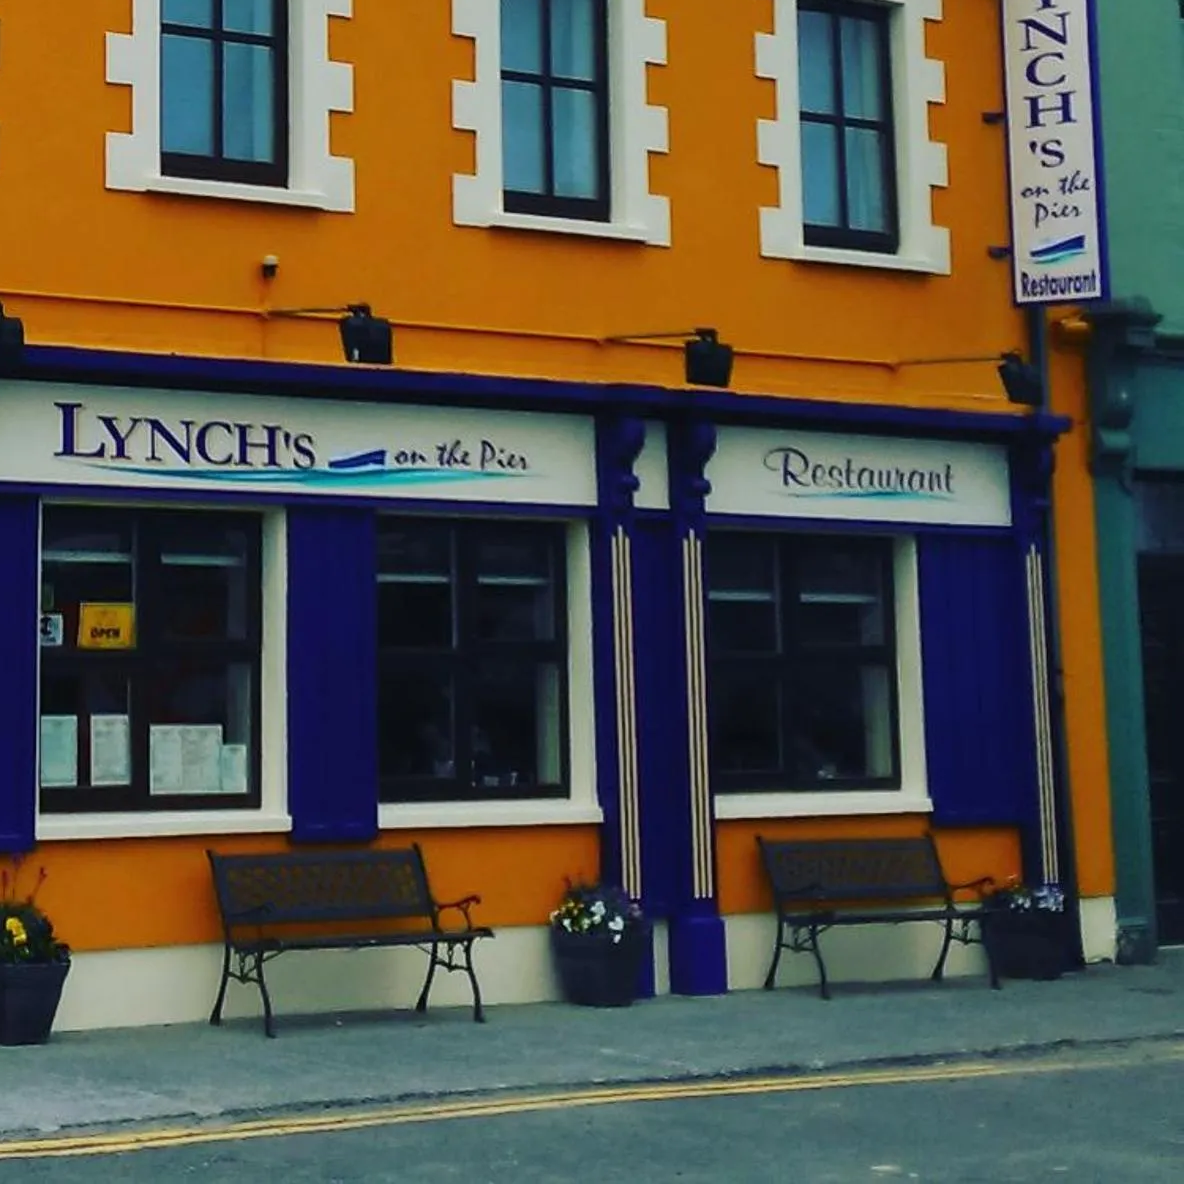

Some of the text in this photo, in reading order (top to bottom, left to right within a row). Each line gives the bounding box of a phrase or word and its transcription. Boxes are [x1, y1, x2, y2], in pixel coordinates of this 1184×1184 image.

[1020, 169, 1091, 198] on the
[1034, 202, 1080, 229] Pier
[1020, 269, 1097, 297] Restaurant
[53, 401, 528, 471] LYNCH'S on the Pier
[763, 446, 956, 494] Restaurant
[90, 626, 121, 639] OPEN
